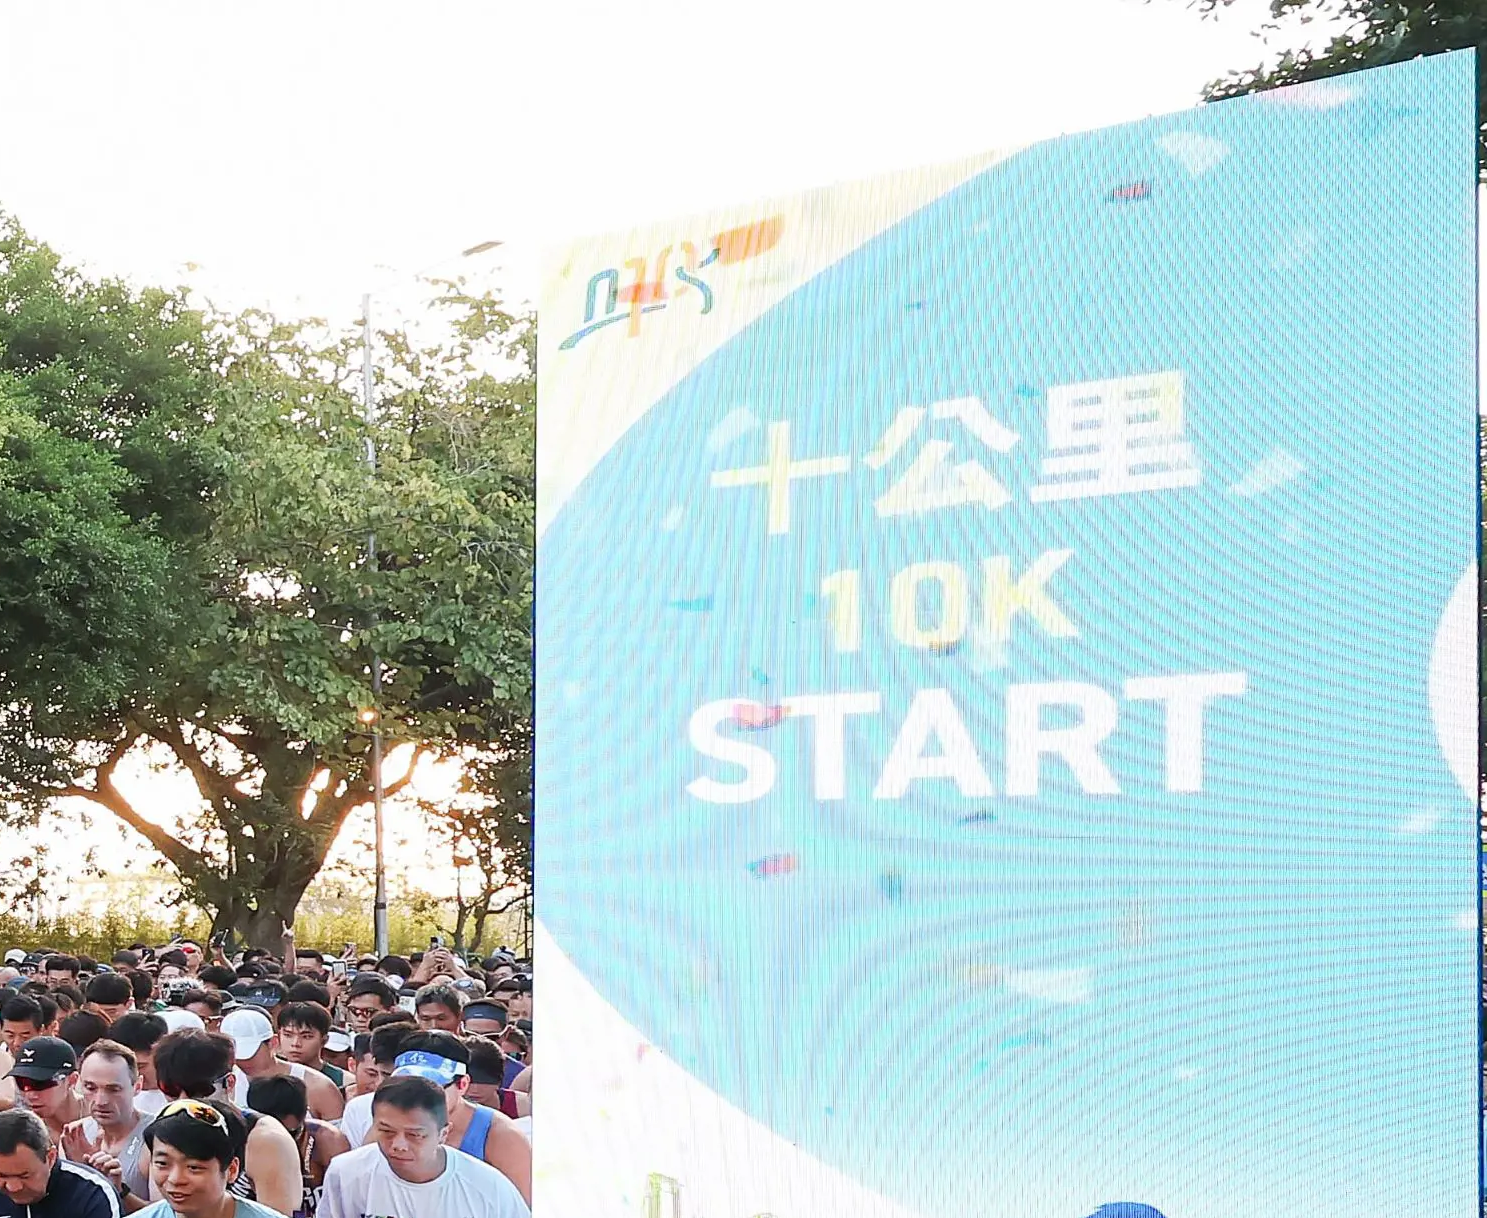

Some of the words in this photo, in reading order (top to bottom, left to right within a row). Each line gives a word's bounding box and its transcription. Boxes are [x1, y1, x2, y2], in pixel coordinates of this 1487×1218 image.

[710, 368, 1203, 537] 十公里
[821, 547, 1080, 655] 10K
[686, 671, 1249, 805] START
